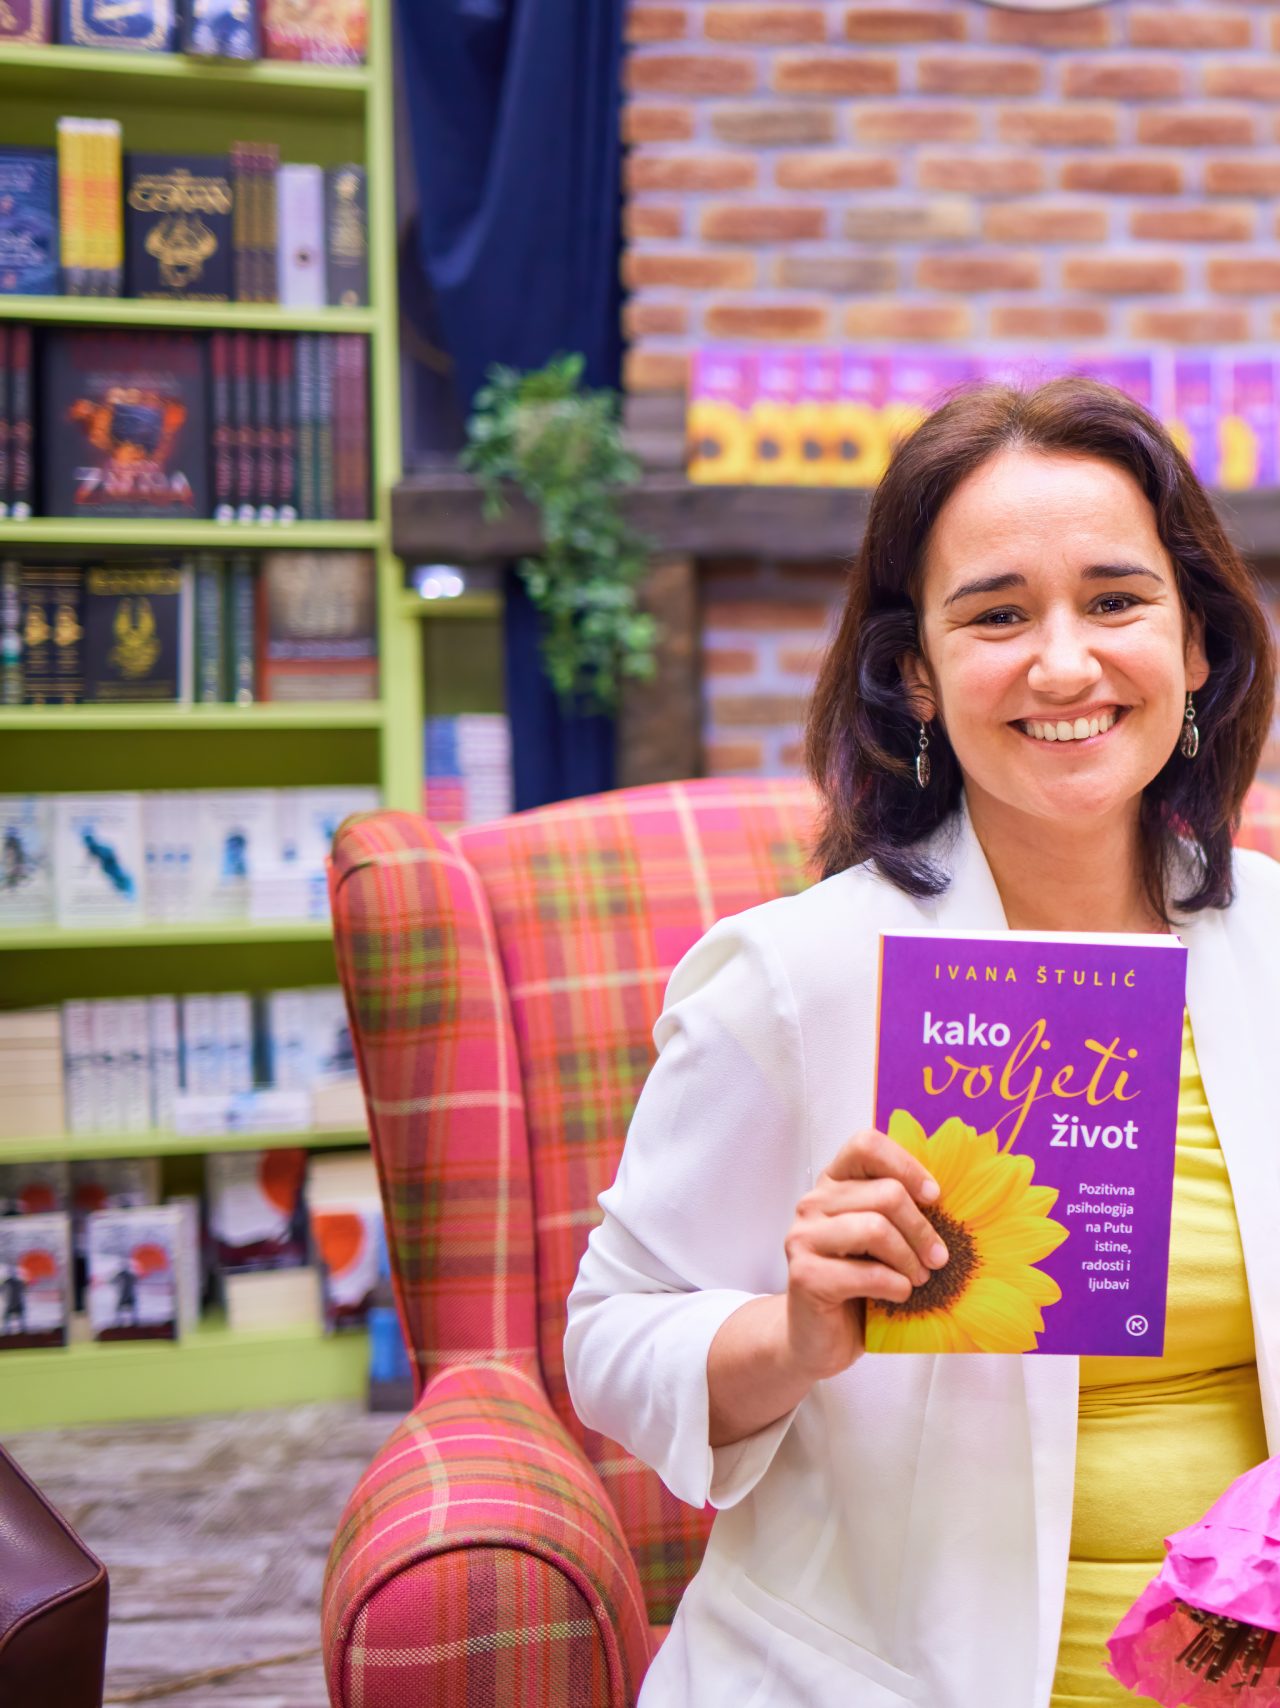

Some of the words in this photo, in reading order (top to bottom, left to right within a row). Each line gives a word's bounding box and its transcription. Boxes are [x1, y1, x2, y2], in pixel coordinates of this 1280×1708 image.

[934, 964, 1017, 982] IVANA
[1036, 965, 1136, 988] ŠTULIĆ
[923, 1011, 1011, 1047] kako
[922, 1018, 1142, 1155] voljeti
[1049, 1113, 1139, 1150] život
[1079, 1183, 1135, 1196] Pozitivna
[1066, 1202, 1134, 1217] psihologija
[1085, 1224, 1101, 1233] na
[1104, 1222, 1133, 1234] Putu
[1095, 1240, 1132, 1254] istine,
[1082, 1259, 1124, 1271] radosti
[1088, 1278, 1130, 1292] ljubavi
